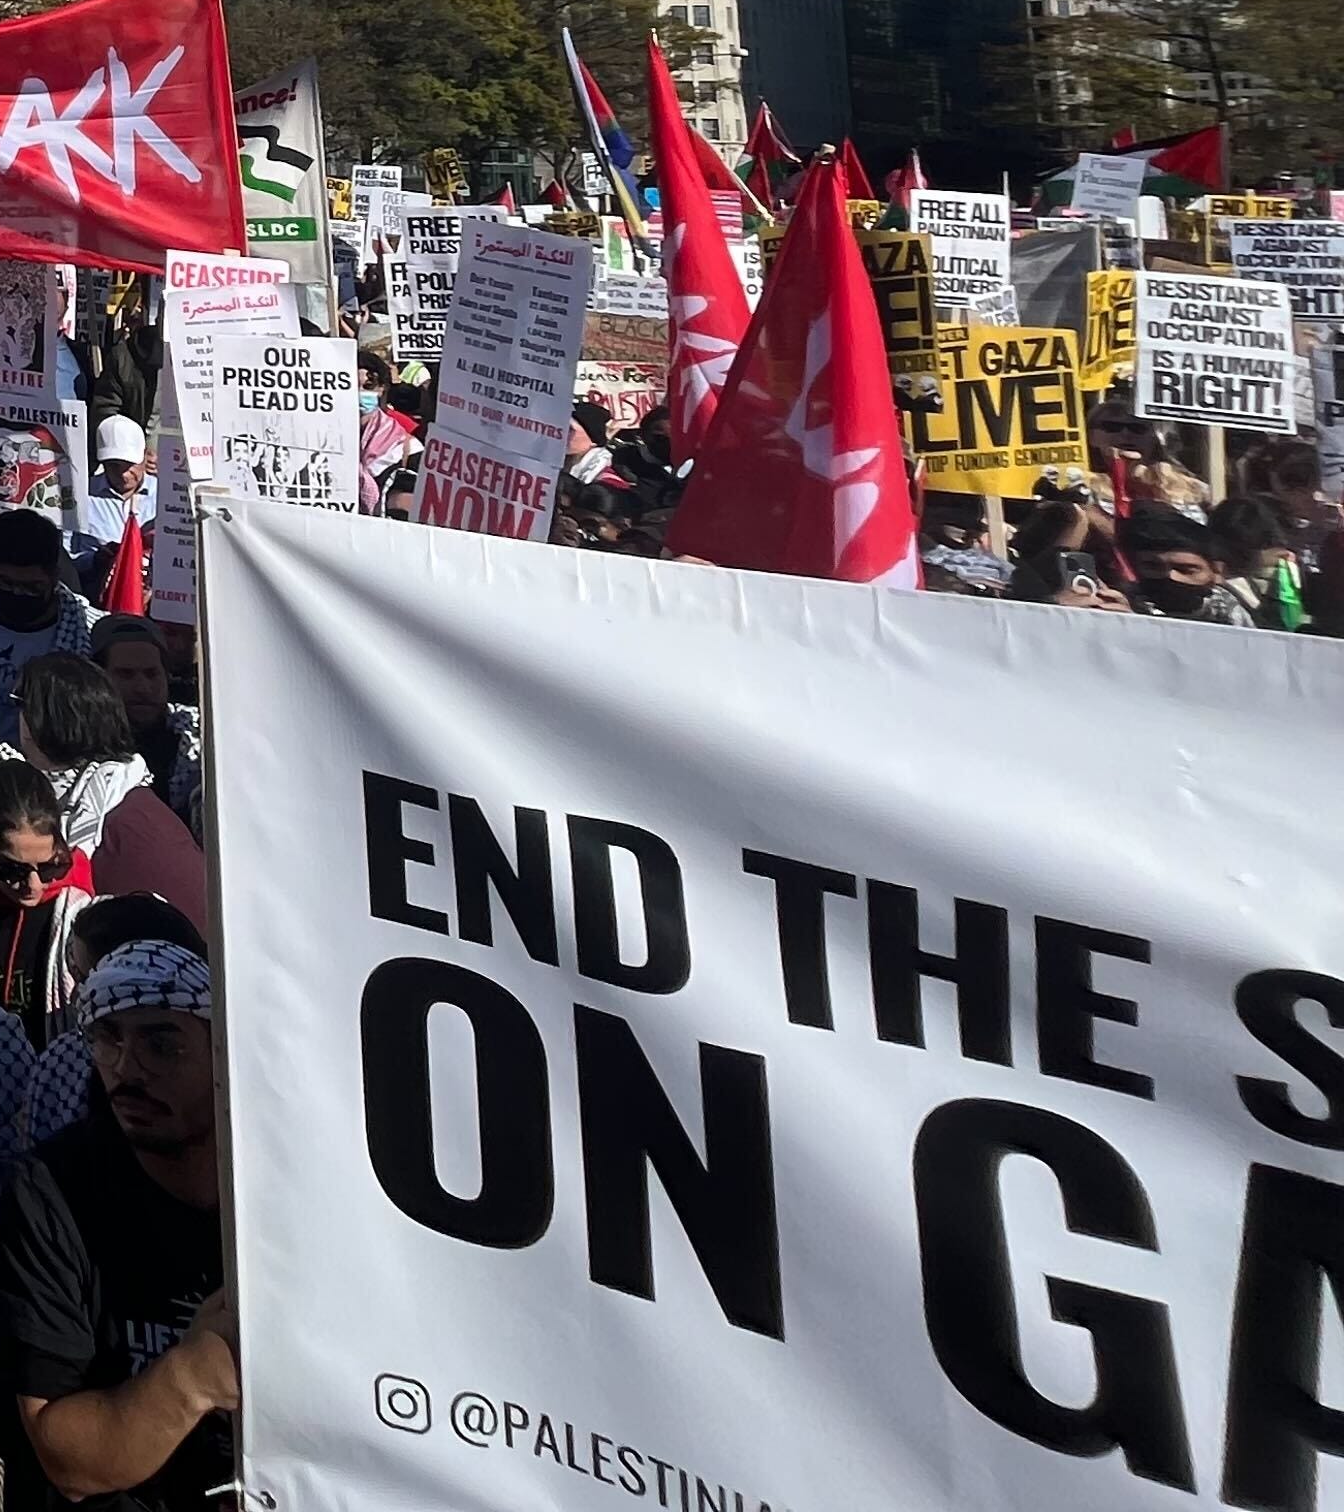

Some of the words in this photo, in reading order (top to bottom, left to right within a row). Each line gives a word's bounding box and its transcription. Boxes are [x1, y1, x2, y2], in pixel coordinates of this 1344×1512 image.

[918, 199, 963, 222] FREE
[970, 202, 1006, 224] ALL
[1212, 199, 1246, 216] END
[1253, 201, 1288, 216] THE
[246, 220, 301, 239] SLDC
[407, 216, 460, 236] FREE
[917, 222, 1006, 242] PALESTINIAN
[1147, 279, 1281, 307] RESISTANCE
[1169, 303, 1264, 327] AGAINST
[1148, 322, 1284, 350] OCCUPATION
[264, 347, 311, 367] OUR
[979, 336, 1072, 376] GAZA
[1153, 350, 1175, 370] IS
[1181, 352, 1196, 371] A
[1203, 353, 1284, 379] HUMAN
[222, 367, 351, 390] PRISONERS
[239, 390, 298, 411] LEAD
[304, 393, 333, 412] US
[1153, 370, 1283, 416] RIGHT!
[9, 406, 79, 427] PALESTINE
[506, 410, 563, 440] MARTYRS
[912, 372, 1079, 454] LIVE!
[424, 438, 552, 511] CEASEFIRE
[420, 473, 537, 539] NOW
[360, 769, 692, 997] END
[740, 846, 1156, 1102] THE
[359, 956, 786, 1344] ON
